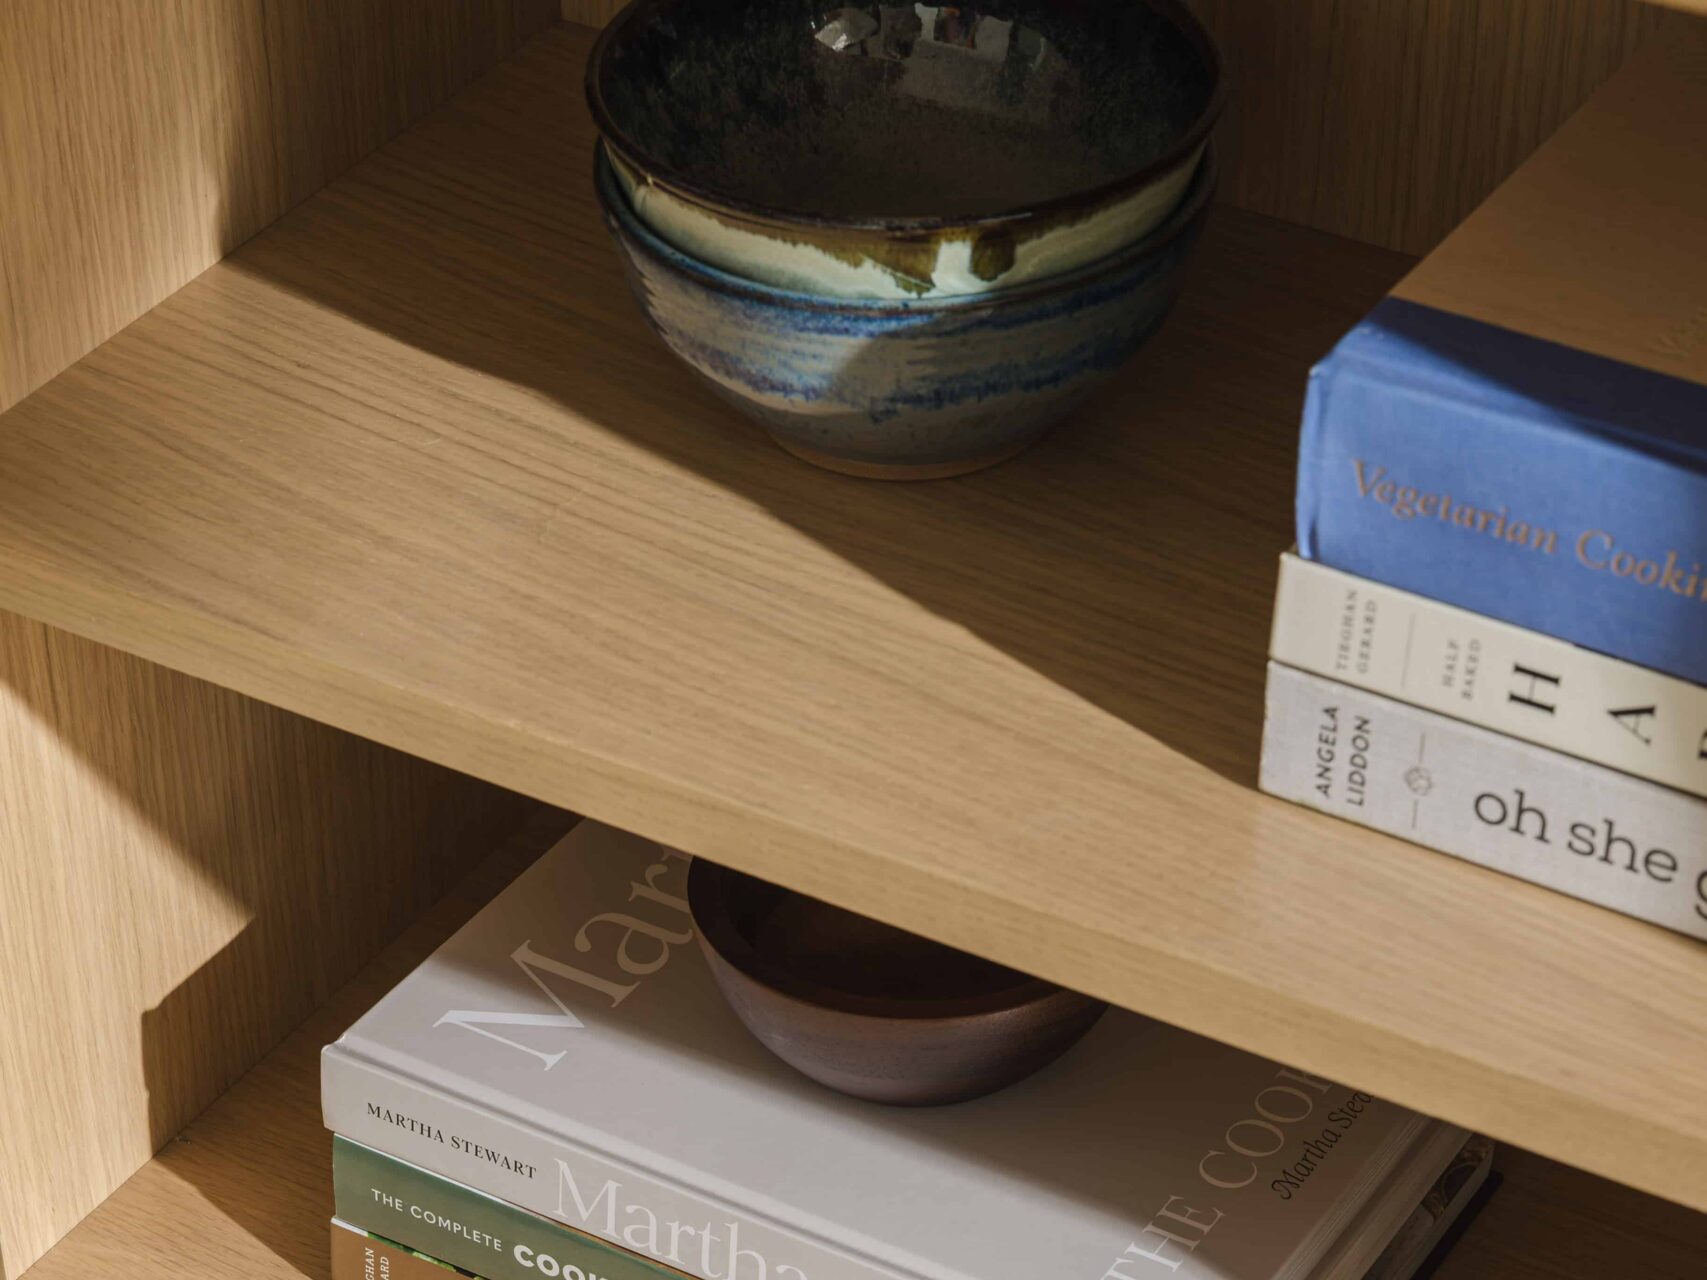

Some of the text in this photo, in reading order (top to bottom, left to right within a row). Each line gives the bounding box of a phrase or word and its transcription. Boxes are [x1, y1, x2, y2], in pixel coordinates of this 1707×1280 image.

[1353, 458, 1707, 603] Vegetarian Cooki
[1357, 600, 1377, 674] GERARD
[1441, 638, 1459, 687] HALF
[1461, 638, 1481, 700] BAKED
[1315, 704, 1340, 799] ANGELA
[1346, 715, 1371, 807] LIDDON
[1474, 789, 1679, 883] oh she
[432, 848, 693, 1072] Mar
[367, 1102, 537, 1179] MARTHA STEWART
[1271, 1128, 1342, 1201] Martha
[371, 1188, 502, 1251] THE COMPLETE
